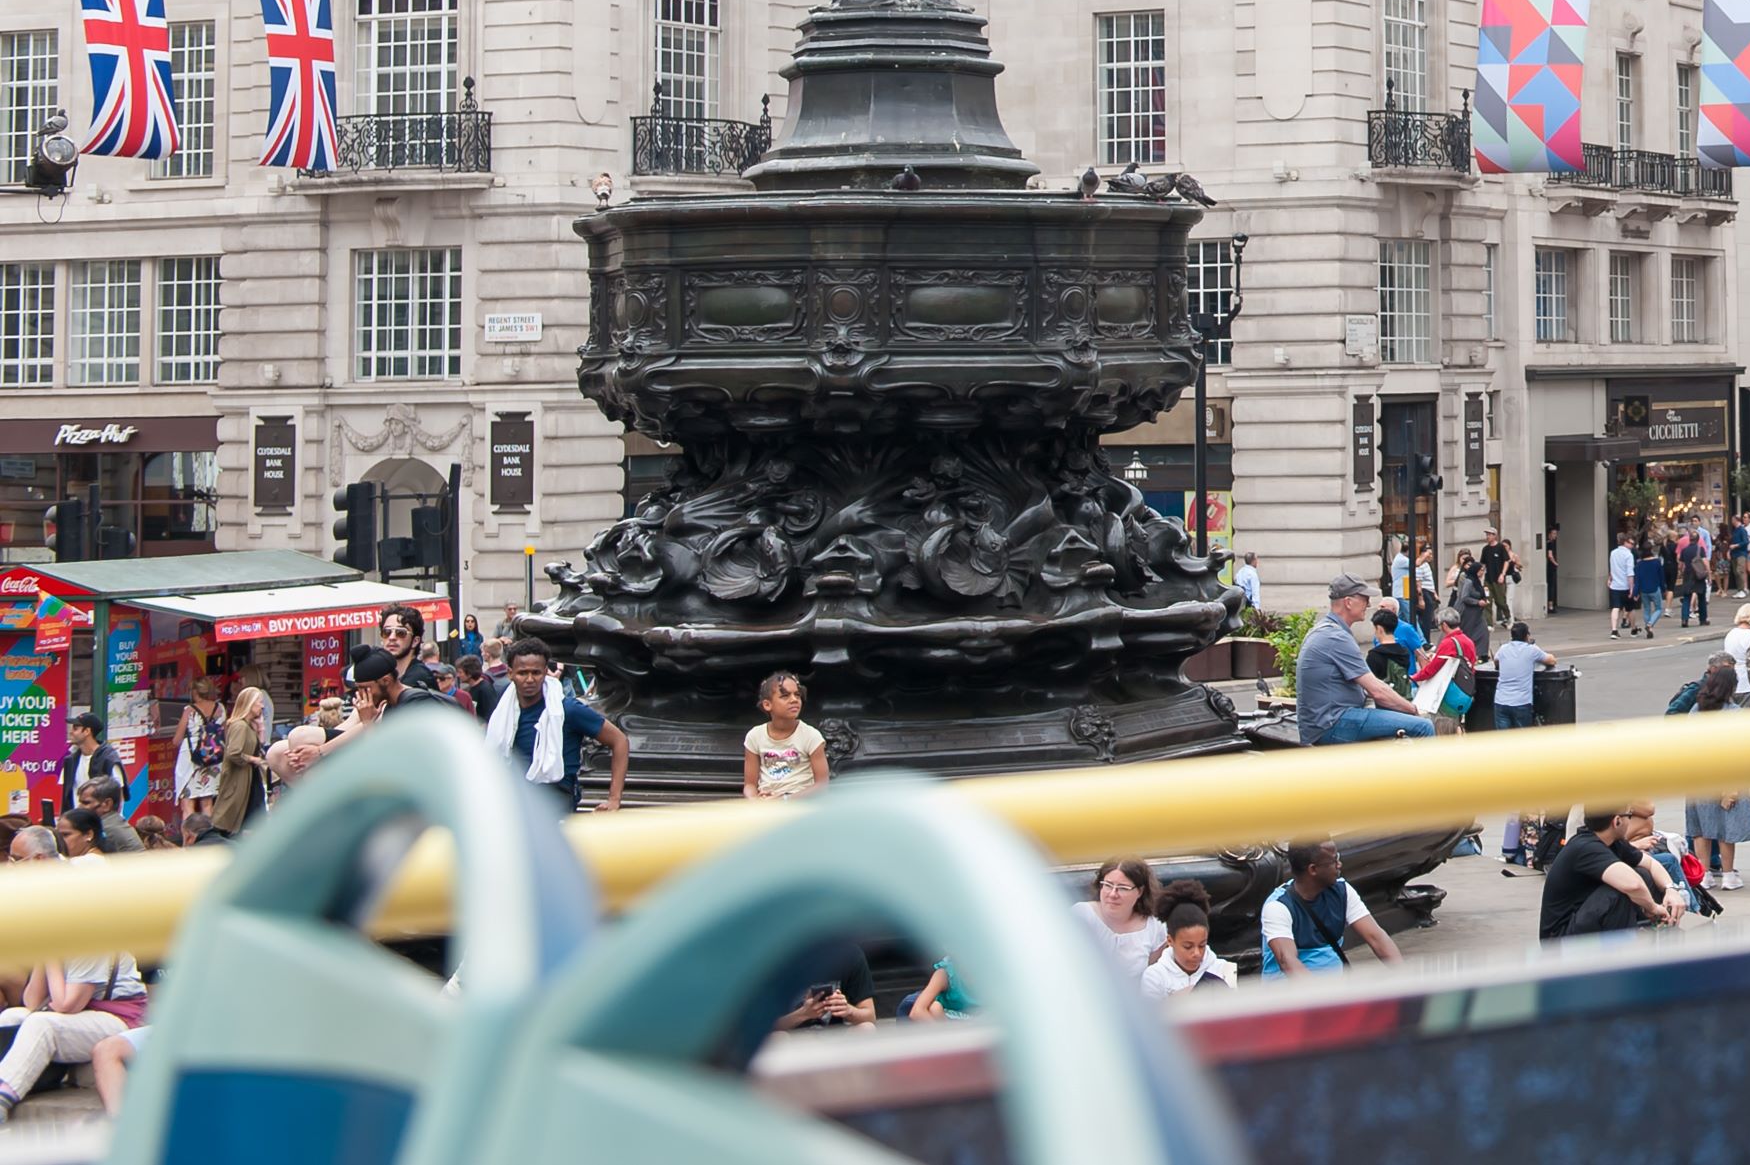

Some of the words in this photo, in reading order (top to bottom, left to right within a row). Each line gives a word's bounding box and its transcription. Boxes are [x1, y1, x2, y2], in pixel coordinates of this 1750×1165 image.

[513, 316, 535, 324] STREET
[54, 424, 101, 446] Pizza
[100, 423, 139, 444] Hut
[1649, 423, 1699, 440] CICCHETTI
[257, 447, 292, 455] CLYDESDALE
[493, 444, 530, 453] CLYDESDALE
[265, 459, 282, 467] BANK
[503, 456, 520, 465] BANK
[264, 470, 284, 479] HOUSE
[501, 467, 522, 476] HOUSE
[269, 619, 293, 633] BUY
[295, 616, 326, 630] YOUR
[328, 611, 374, 627] TICKETS
[119, 641, 135, 650] BUY
[311, 639, 326, 651] Hop
[329, 636, 339, 649] On
[115, 651, 138, 661] YOUR
[310, 655, 326, 668] Hop
[328, 653, 339, 665] Off
[109, 662, 143, 673] TICKETS
[115, 674, 138, 684] HERE
[0, 696, 15, 709] UY
[17, 696, 56, 710] YOUR
[2, 730, 39, 744] HERE
[22, 761, 41, 773] Hop
[42, 760, 57, 772] Off
